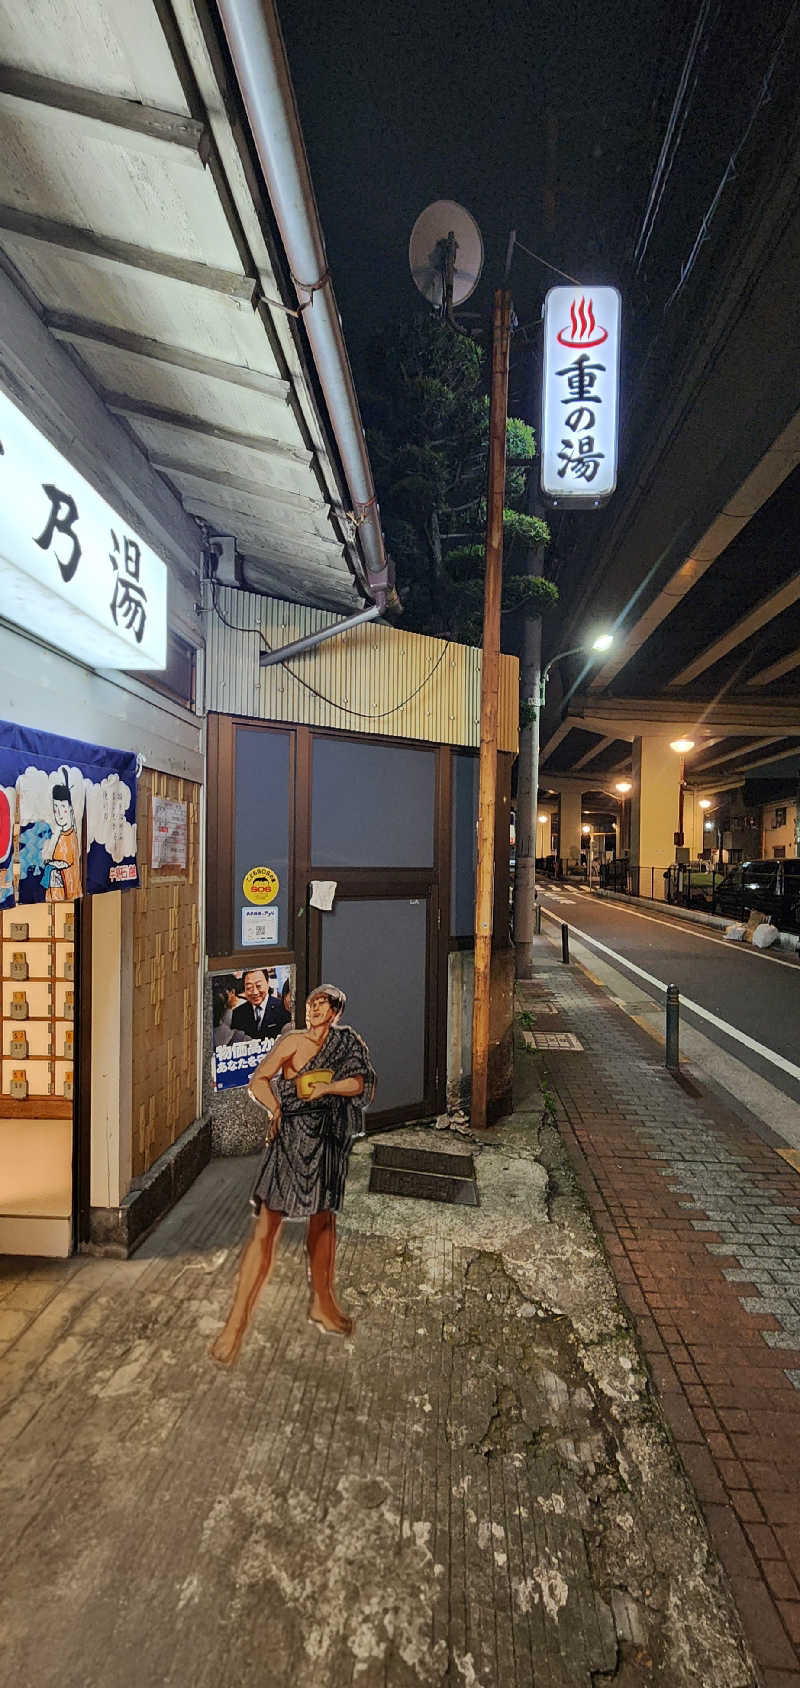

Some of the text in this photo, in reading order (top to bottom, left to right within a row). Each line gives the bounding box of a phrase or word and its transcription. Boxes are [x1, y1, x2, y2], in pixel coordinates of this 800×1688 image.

[555, 353, 606, 482] 重の湯
[0, 437, 147, 643] 乃湯
